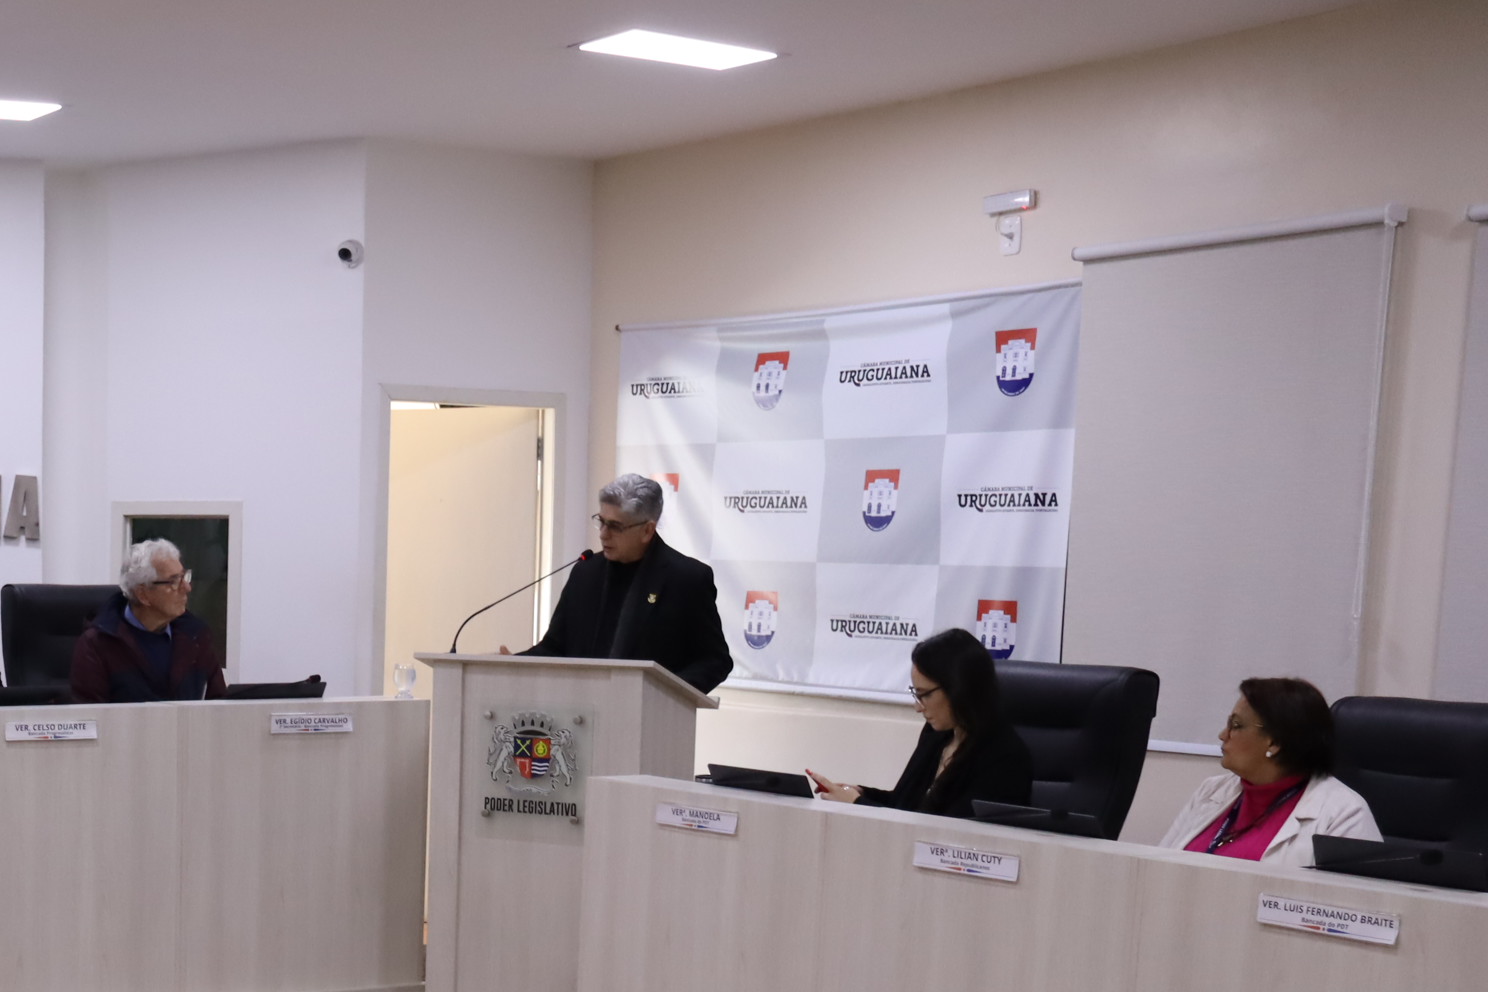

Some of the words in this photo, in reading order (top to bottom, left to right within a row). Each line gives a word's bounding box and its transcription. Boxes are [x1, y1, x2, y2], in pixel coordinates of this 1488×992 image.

[839, 364, 931, 387] URUGUAIANA
[630, 382, 704, 399] URUGUAIAN
[724, 496, 808, 513] URUGUAIANA
[957, 492, 1058, 513] URUGUAIANA
[830, 619, 918, 638] URUGUAIANA
[57, 723, 87, 731] DUARTE
[314, 717, 348, 725] CARVALHO
[484, 796, 514, 813] PODER
[517, 799, 577, 817] LEGISLATIVO
[952, 849, 979, 862] LILIAN
[981, 854, 1002, 865] CUTY
[1262, 899, 1281, 910] VER.
[1284, 903, 1304, 914] LUIS
[1306, 907, 1358, 923] FERNANDO
[1360, 915, 1394, 928] BRAITE
[1301, 916, 1326, 927] Bancada
